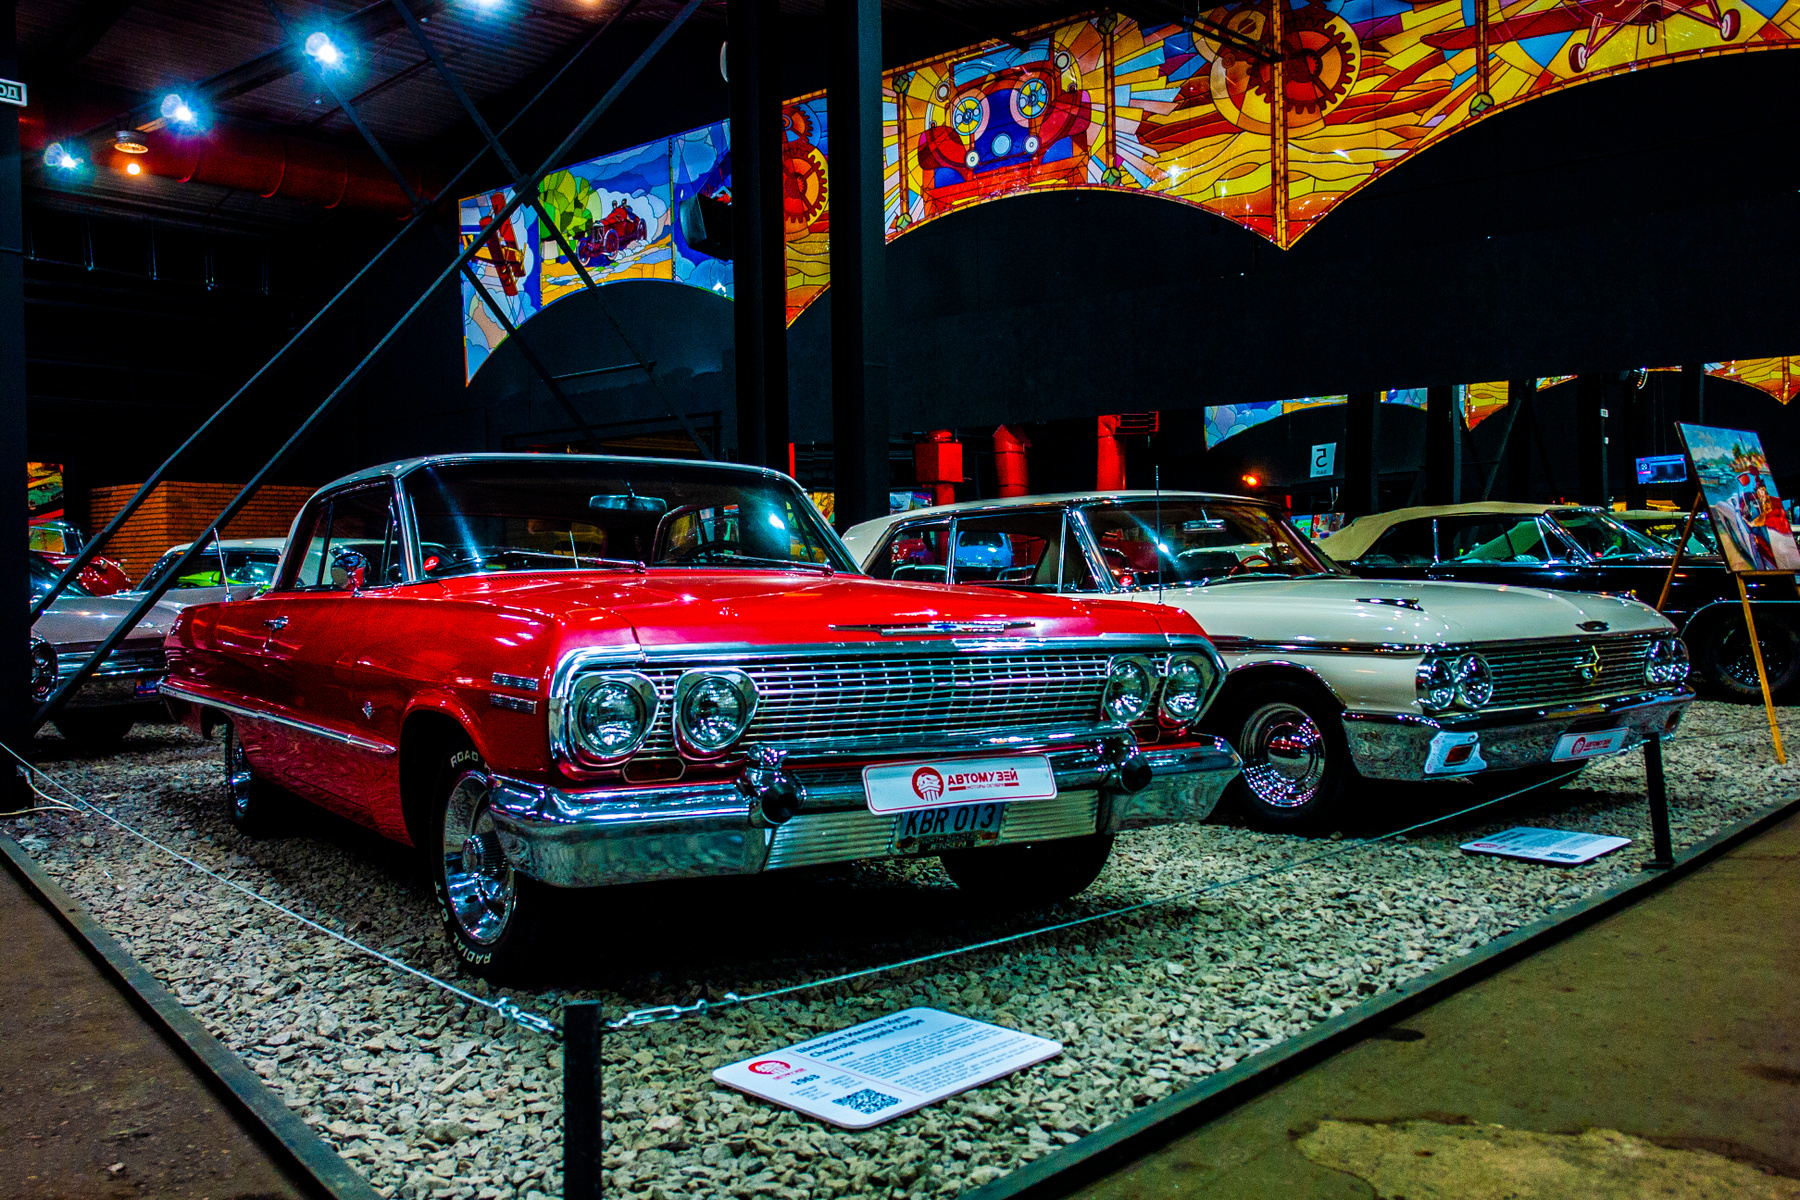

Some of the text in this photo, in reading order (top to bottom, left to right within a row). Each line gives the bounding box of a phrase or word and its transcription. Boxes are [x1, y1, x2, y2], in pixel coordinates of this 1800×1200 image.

[450, 750, 479, 768] ROAD
[947, 767, 1018, 786] АВТОМУЗЕЙ
[904, 804, 996, 835] KBR 013
[453, 931, 492, 965] RADIAL
[791, 1073, 821, 1086] 1963
